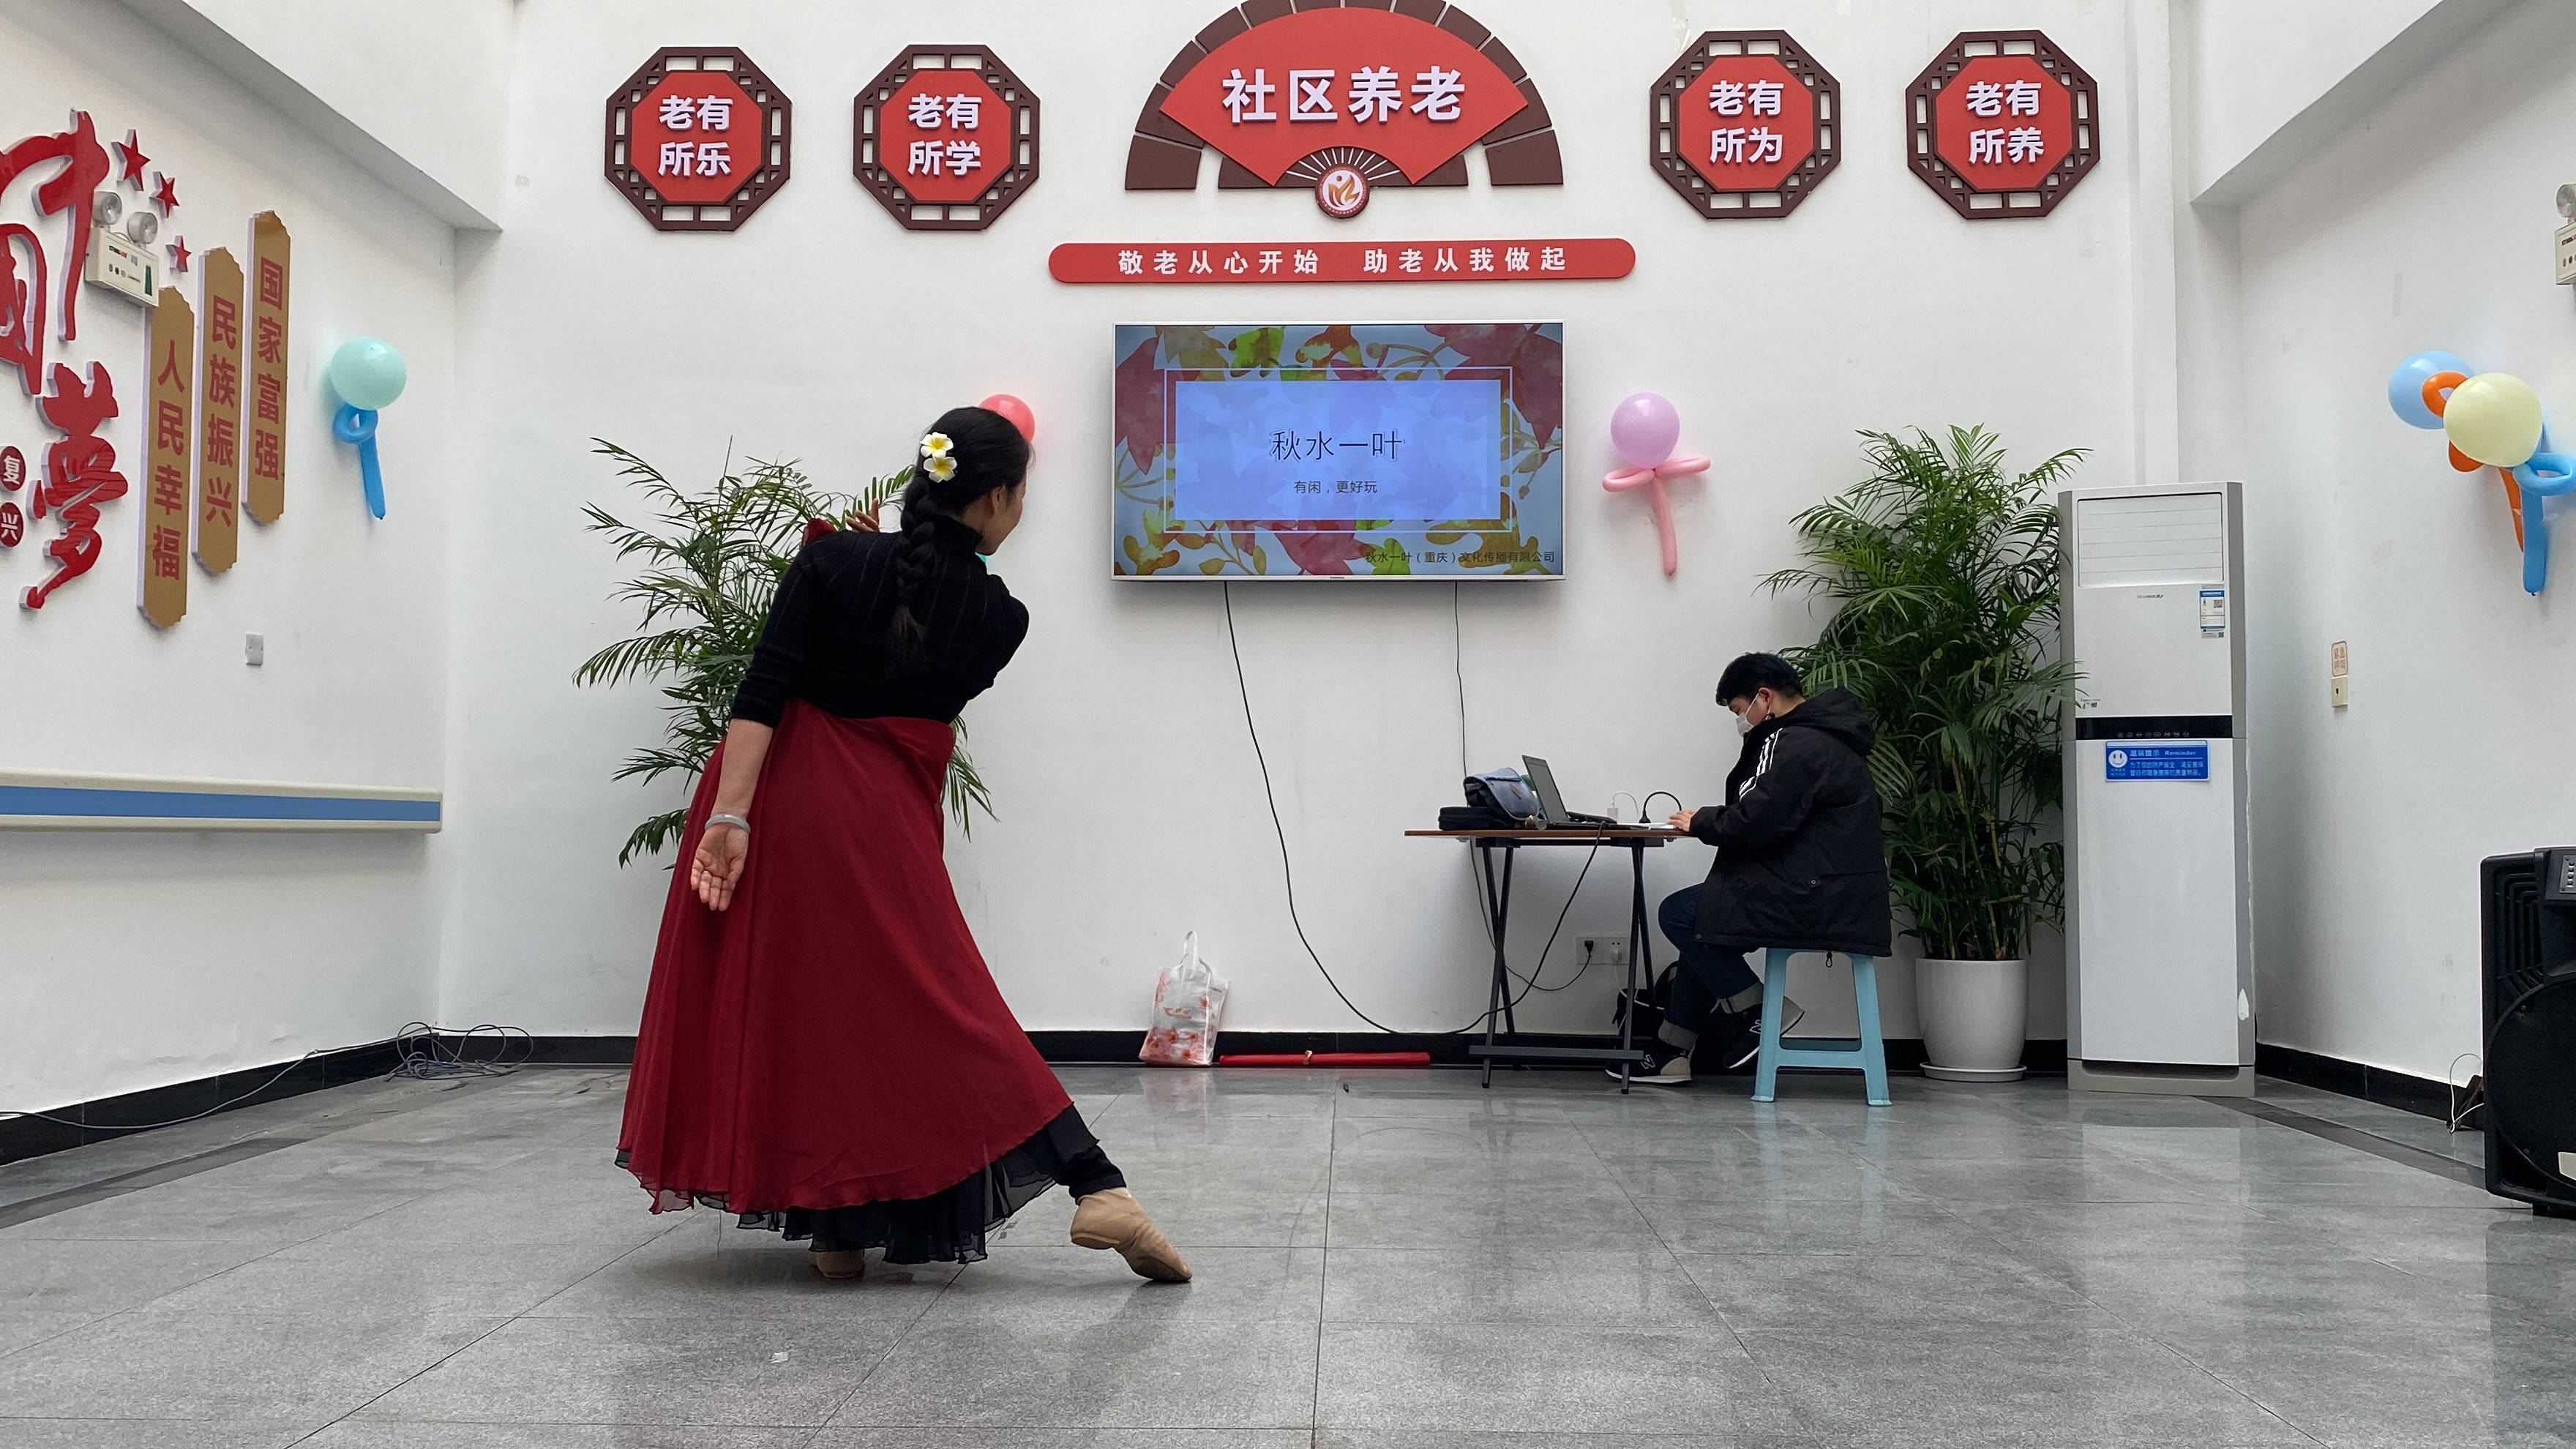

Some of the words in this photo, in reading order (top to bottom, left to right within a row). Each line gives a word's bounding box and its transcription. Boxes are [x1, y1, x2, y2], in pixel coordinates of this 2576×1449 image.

[659, 95, 733, 130] 老有
[908, 94, 982, 129] 老有
[1223, 66, 1465, 123] 社区养老
[1710, 80, 1784, 116] 老有
[1966, 80, 2042, 116] 老有
[658, 141, 732, 176] 所乐
[907, 141, 981, 176] 所学
[1710, 127, 1783, 163] 所为
[1969, 127, 2045, 164] 所养
[1118, 250, 1319, 275] 敬老从心开始
[1363, 246, 1566, 274] 助老从我做起
[254, 258, 283, 480] 国家富强
[206, 296, 236, 527] 民族振兴
[152, 340, 186, 580] 人民幸福
[1272, 430, 1402, 460] 秋水一叶
